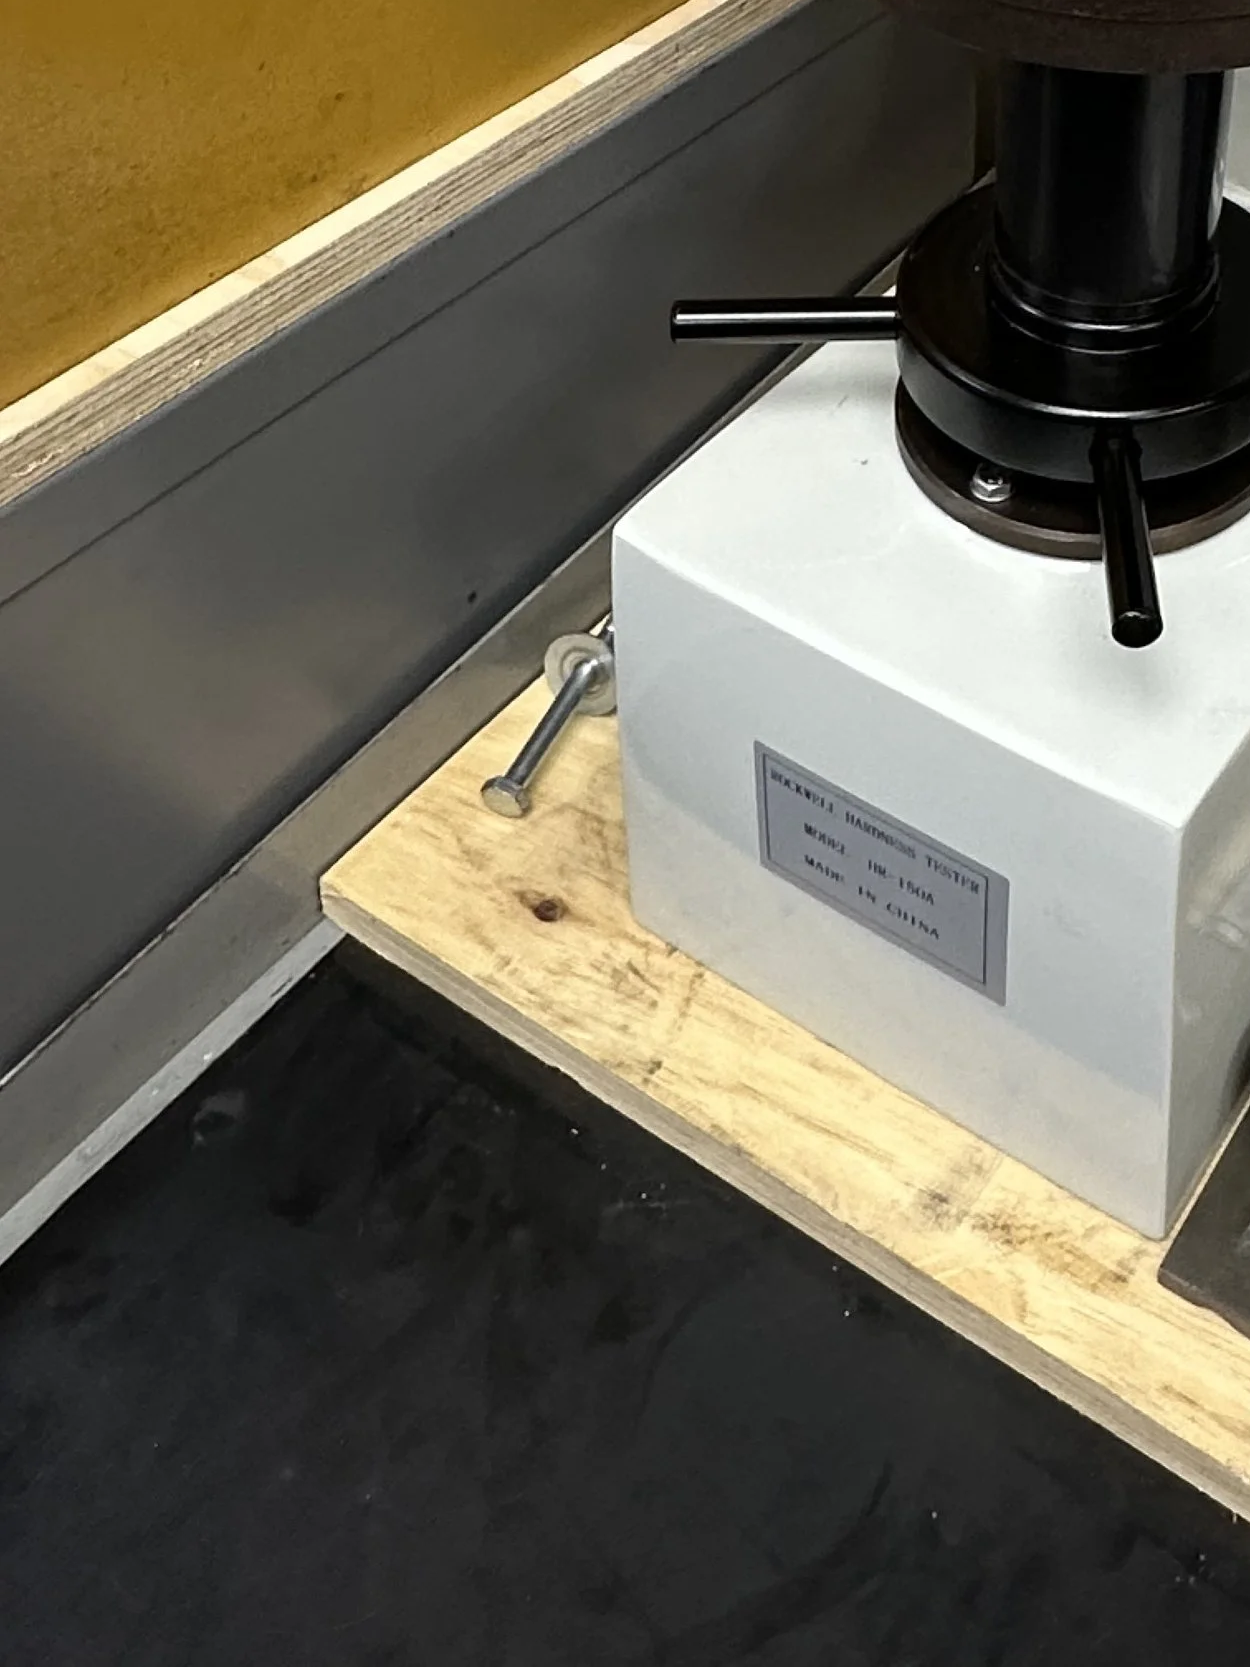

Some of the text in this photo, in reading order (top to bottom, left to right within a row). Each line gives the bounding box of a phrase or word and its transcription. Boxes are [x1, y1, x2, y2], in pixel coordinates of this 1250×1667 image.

[770, 768, 980, 895] ROCKWELL HARDNESS TESTER
[804, 822, 846, 856] MODEL
[804, 854, 939, 940] MADE IN CHINA
